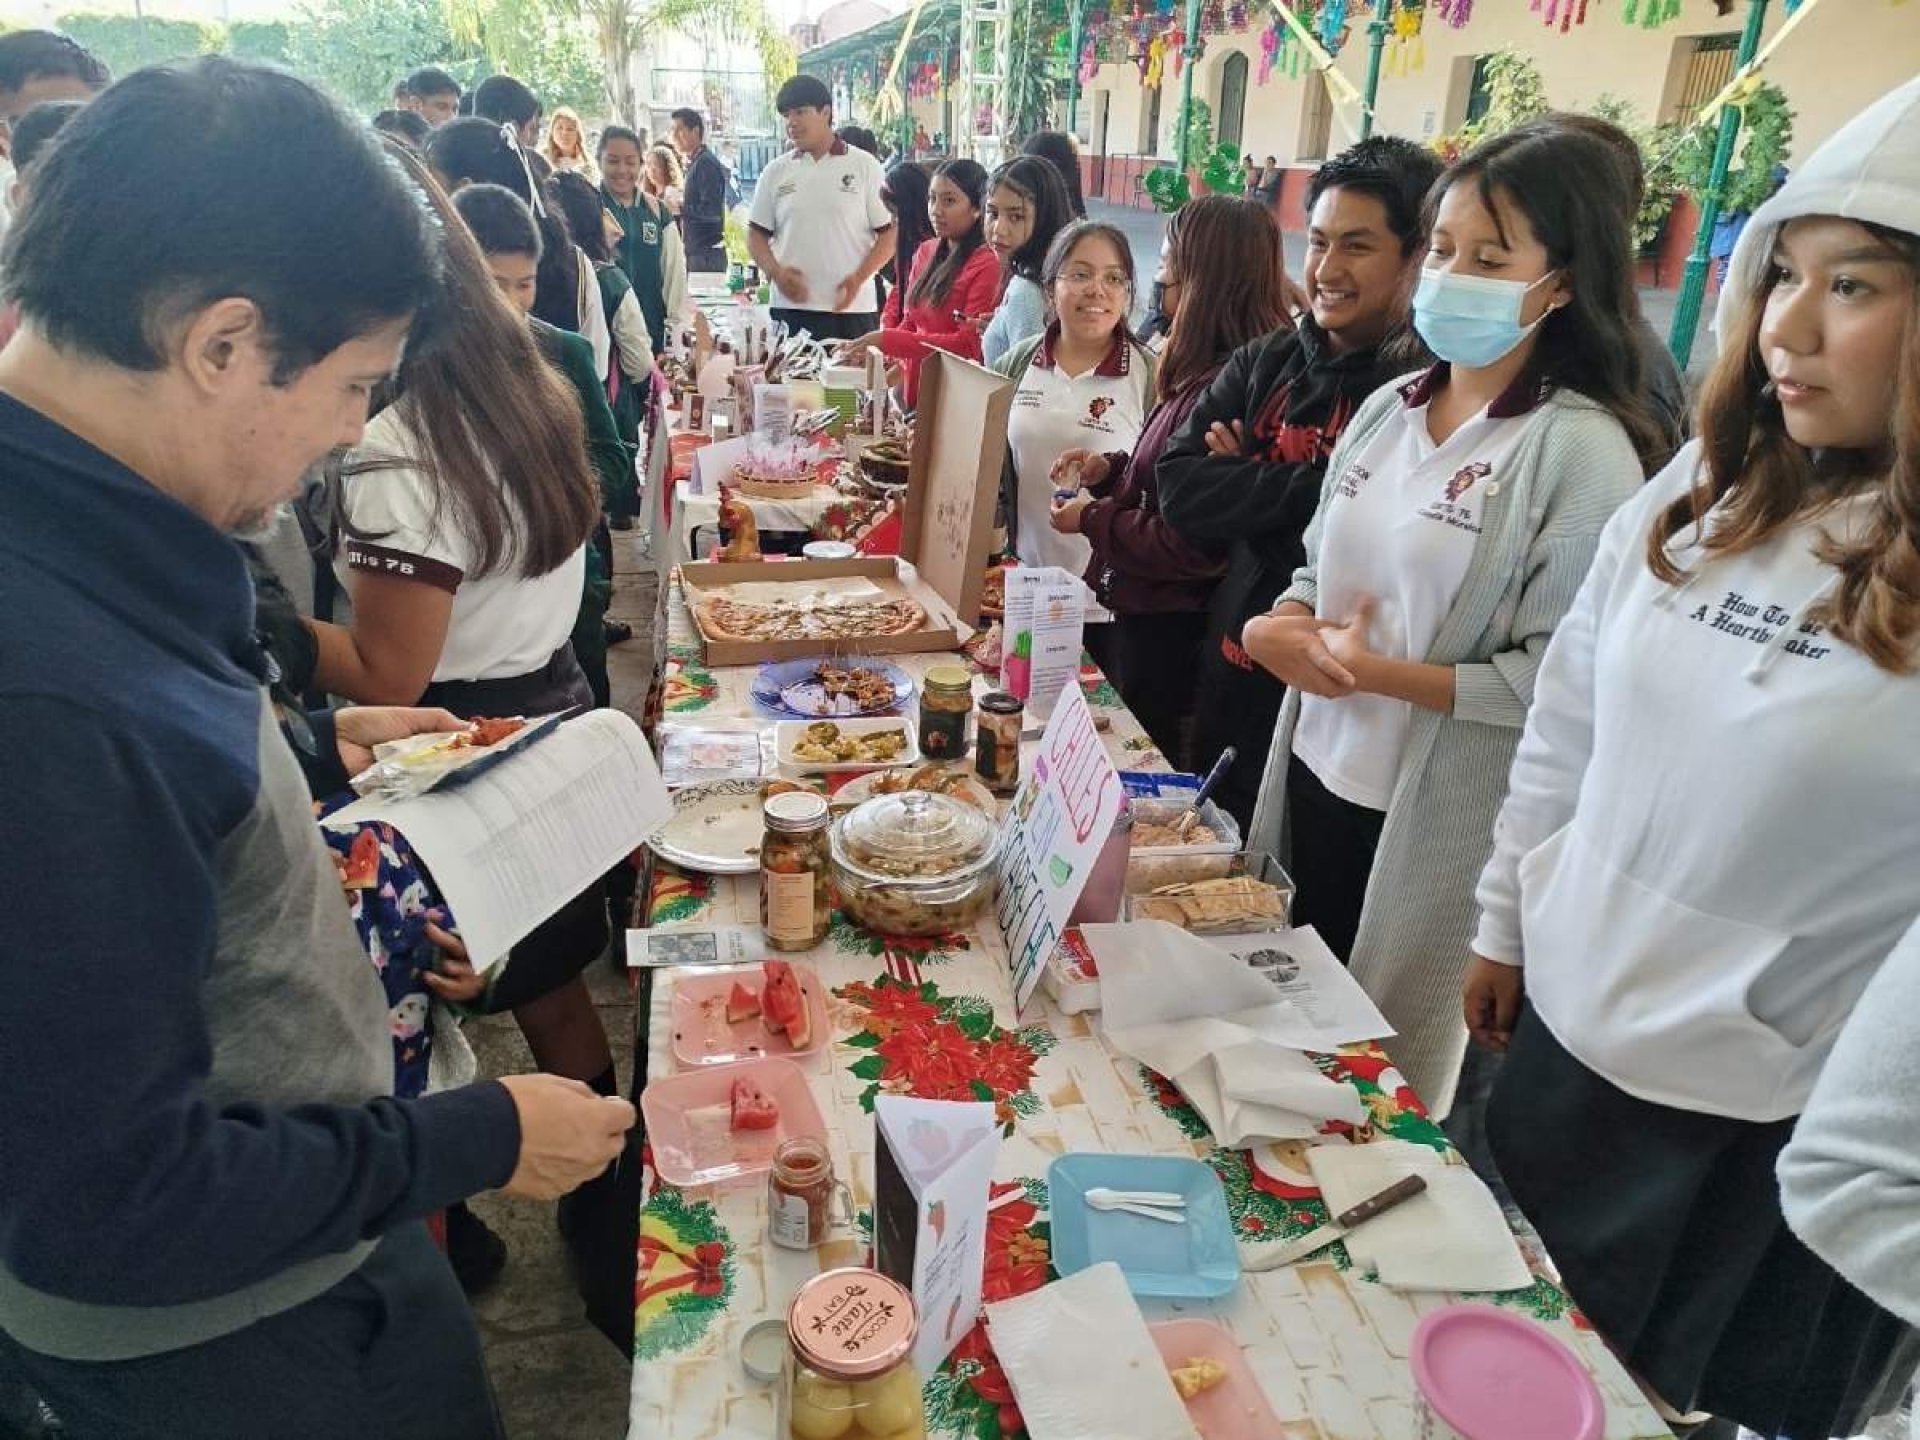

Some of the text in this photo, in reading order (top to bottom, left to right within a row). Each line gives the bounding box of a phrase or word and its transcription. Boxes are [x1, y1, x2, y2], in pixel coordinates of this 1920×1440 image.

[1718, 591, 1759, 617] How
[1762, 604, 1791, 627] To
[1689, 604, 1831, 660] A Heartbaker
[832, 1300, 874, 1337] Taste
